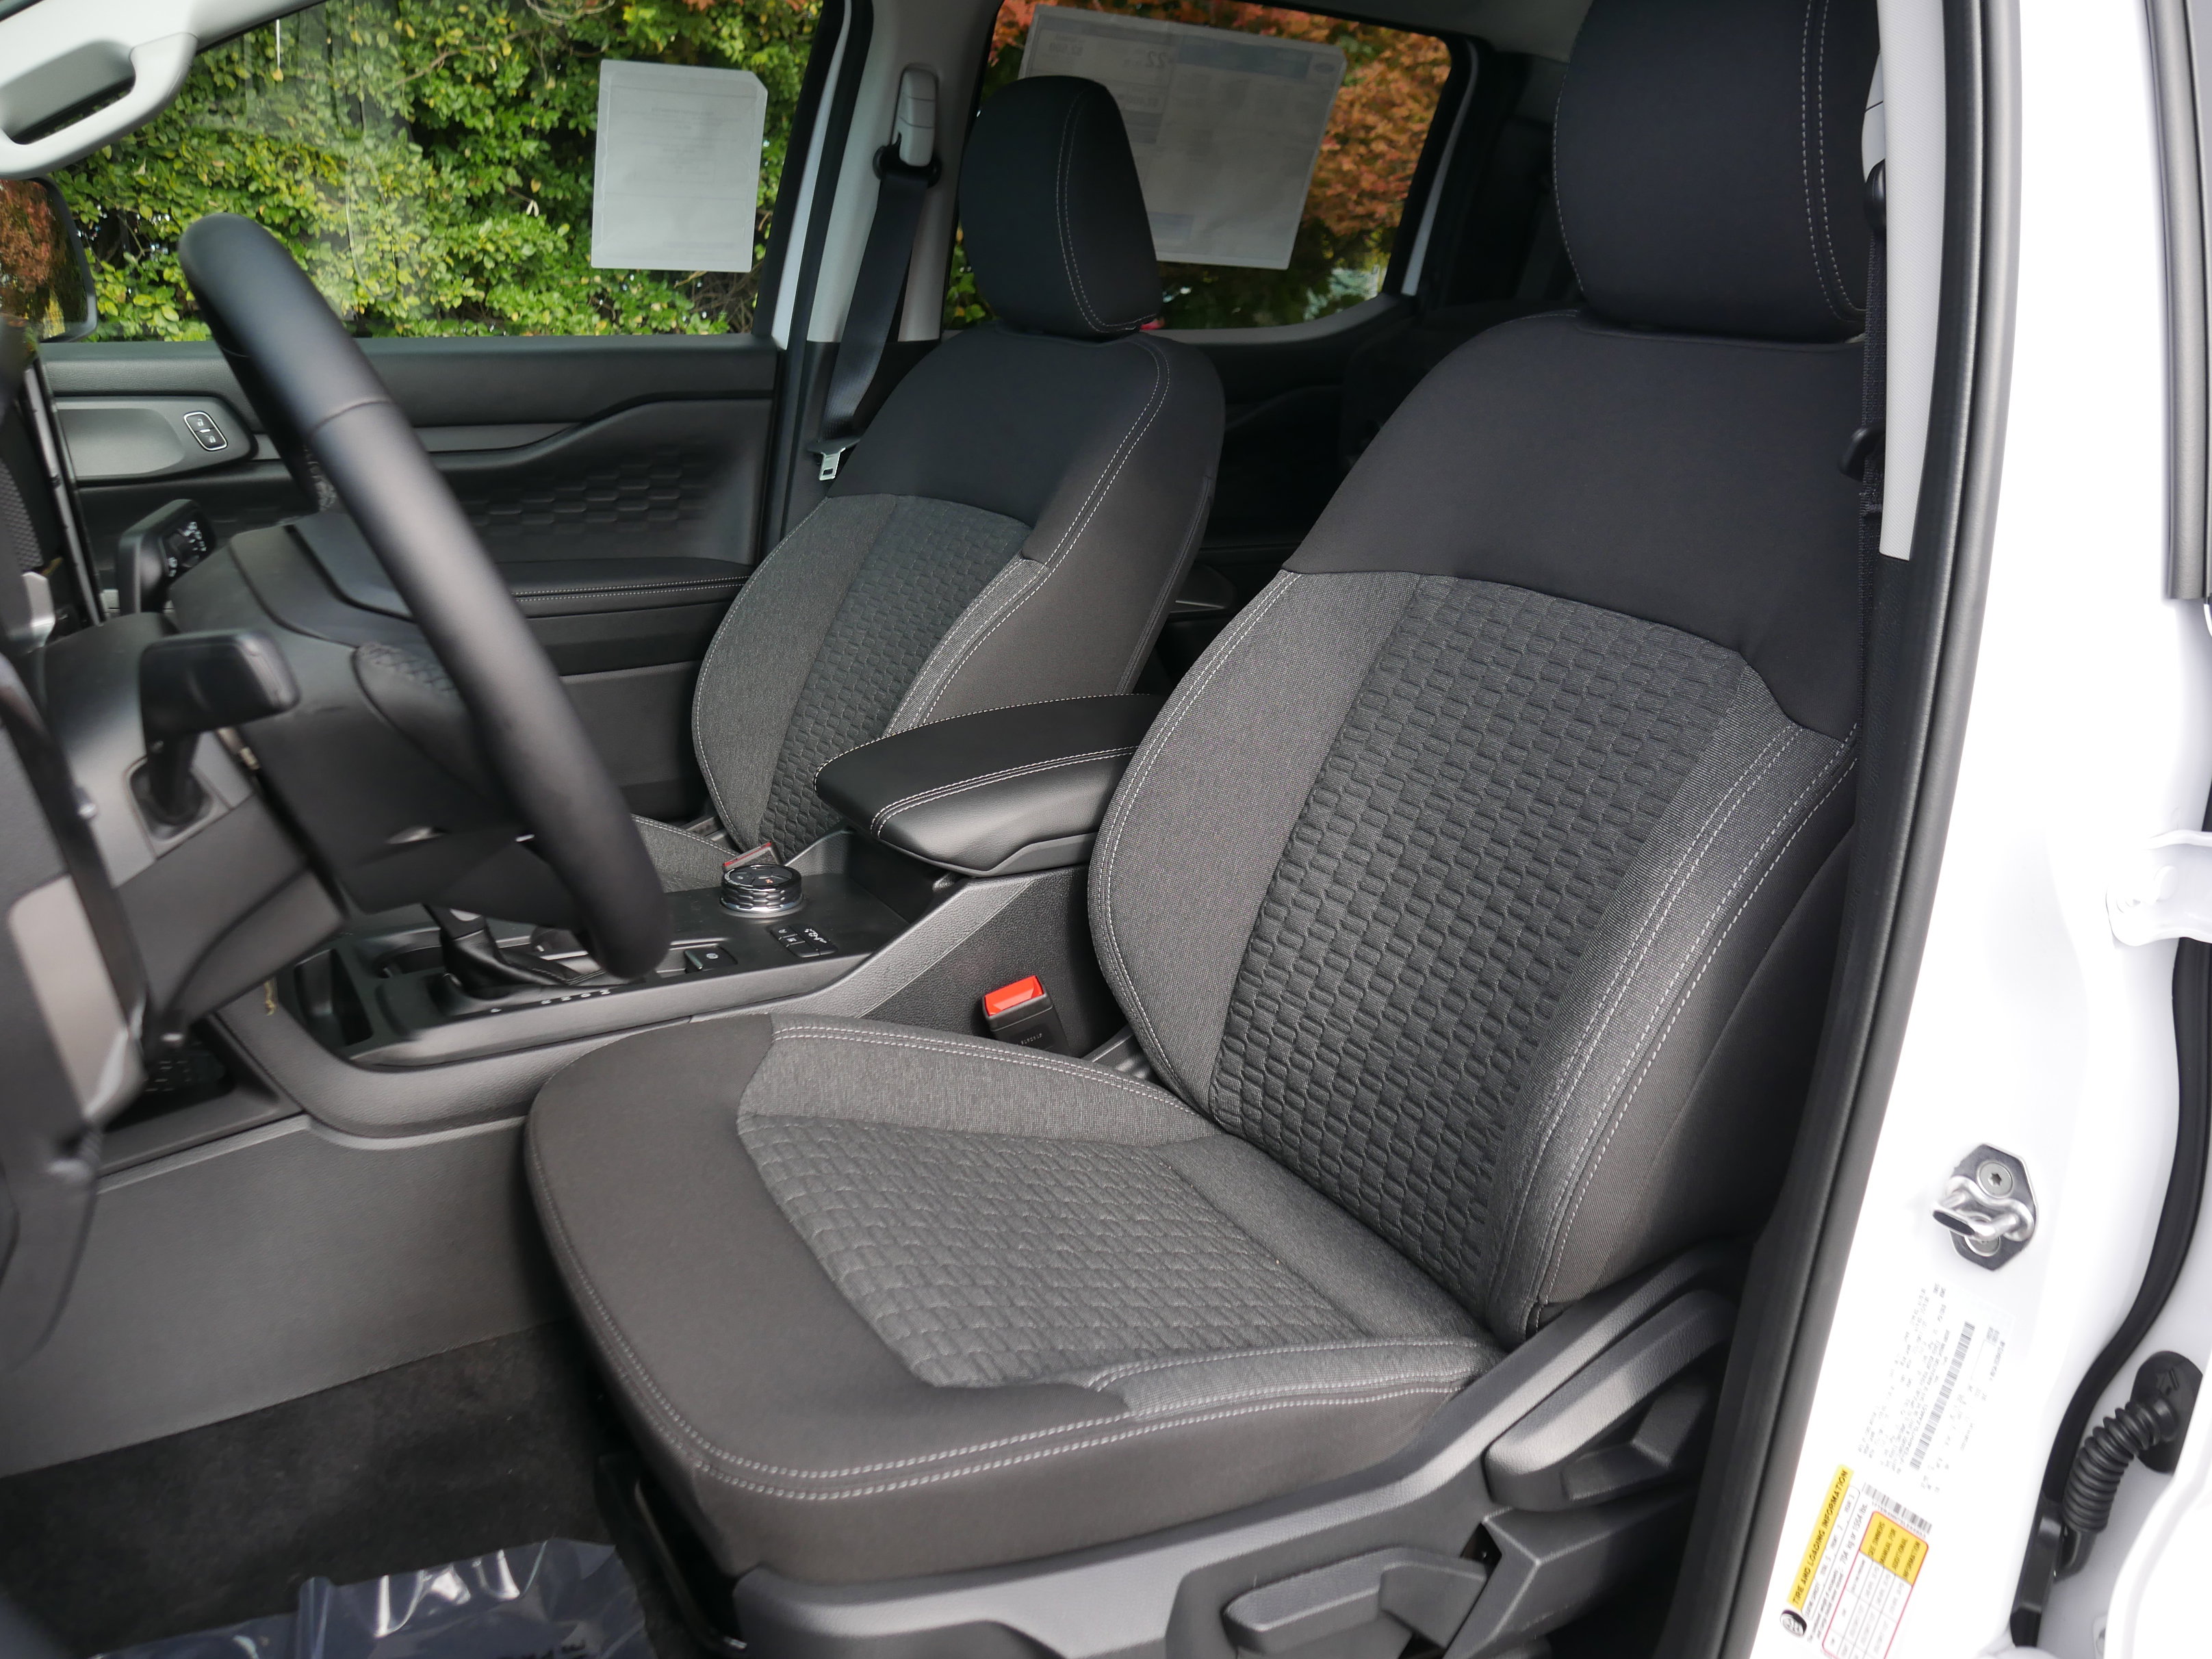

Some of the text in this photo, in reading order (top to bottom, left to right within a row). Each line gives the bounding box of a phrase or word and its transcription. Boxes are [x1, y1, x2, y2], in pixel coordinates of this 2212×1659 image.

[1792, 1468, 1848, 1604] TIRE AND LOADING INFORMATION
[1845, 1540, 1855, 1549] kg
[1867, 1545, 1875, 1557] SEE
[1879, 1541, 1892, 1565] MANUAL
[1888, 1528, 1896, 1541] FOR
[1891, 1538, 1907, 1569] ADDITIONAL
[1901, 1541, 1920, 1579] INFORMATION
